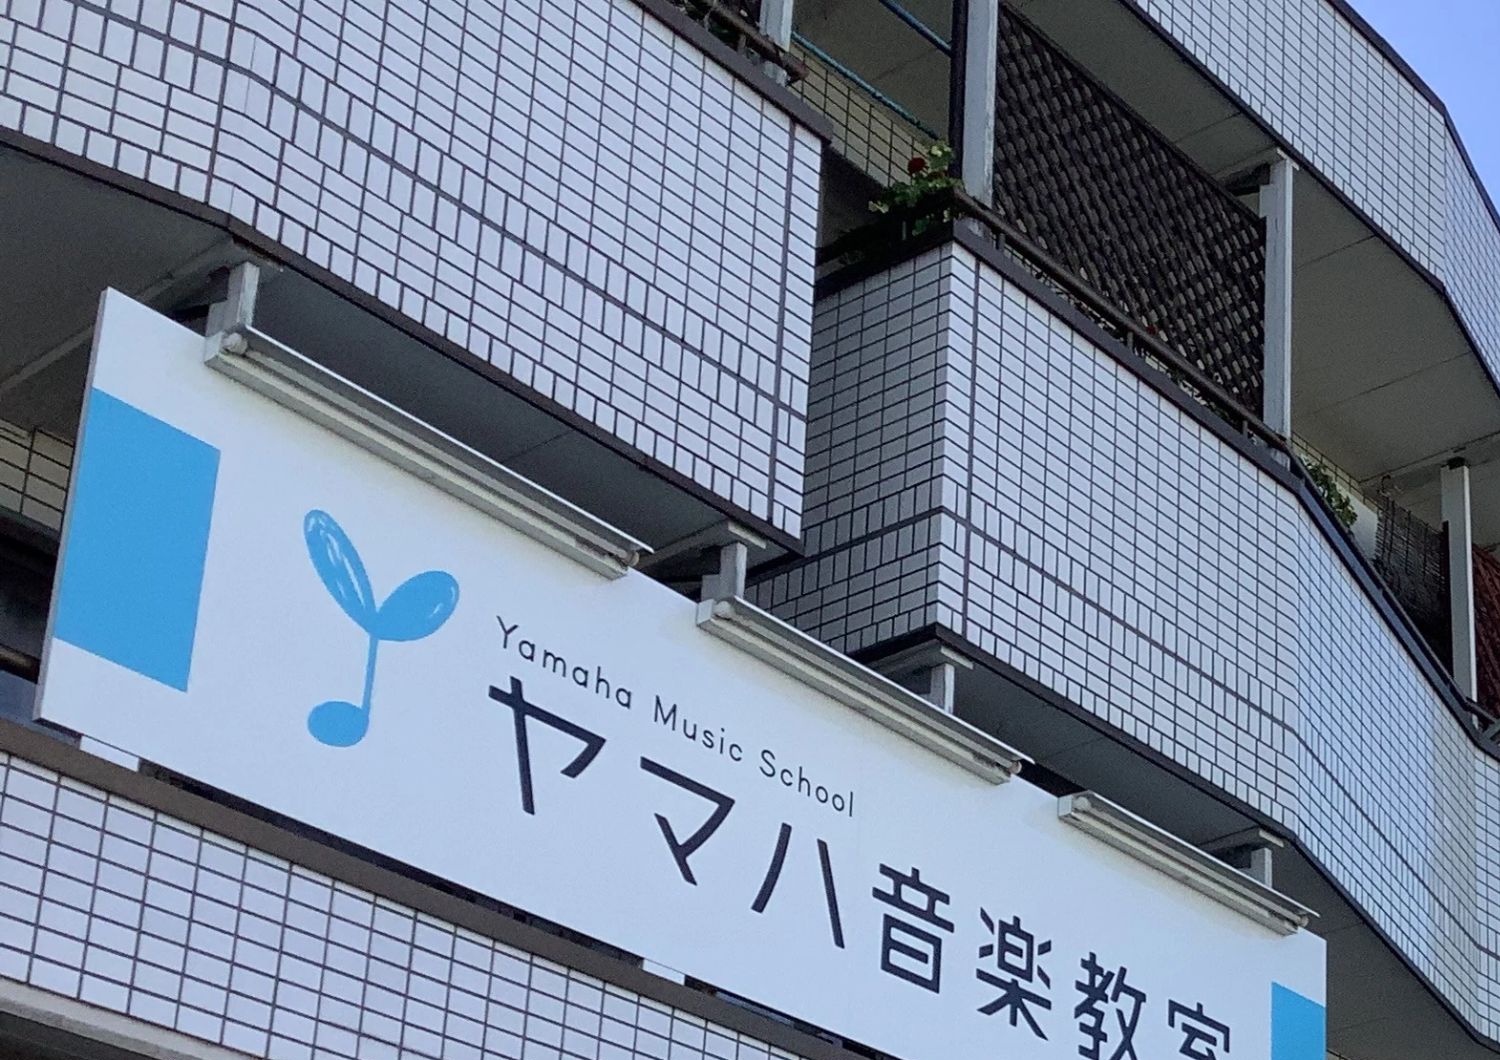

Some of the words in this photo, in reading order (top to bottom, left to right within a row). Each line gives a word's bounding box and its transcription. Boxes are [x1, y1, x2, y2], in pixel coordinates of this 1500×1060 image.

[496, 615, 632, 709] Yamaha
[654, 695, 743, 762] Music
[759, 749, 853, 817] School
